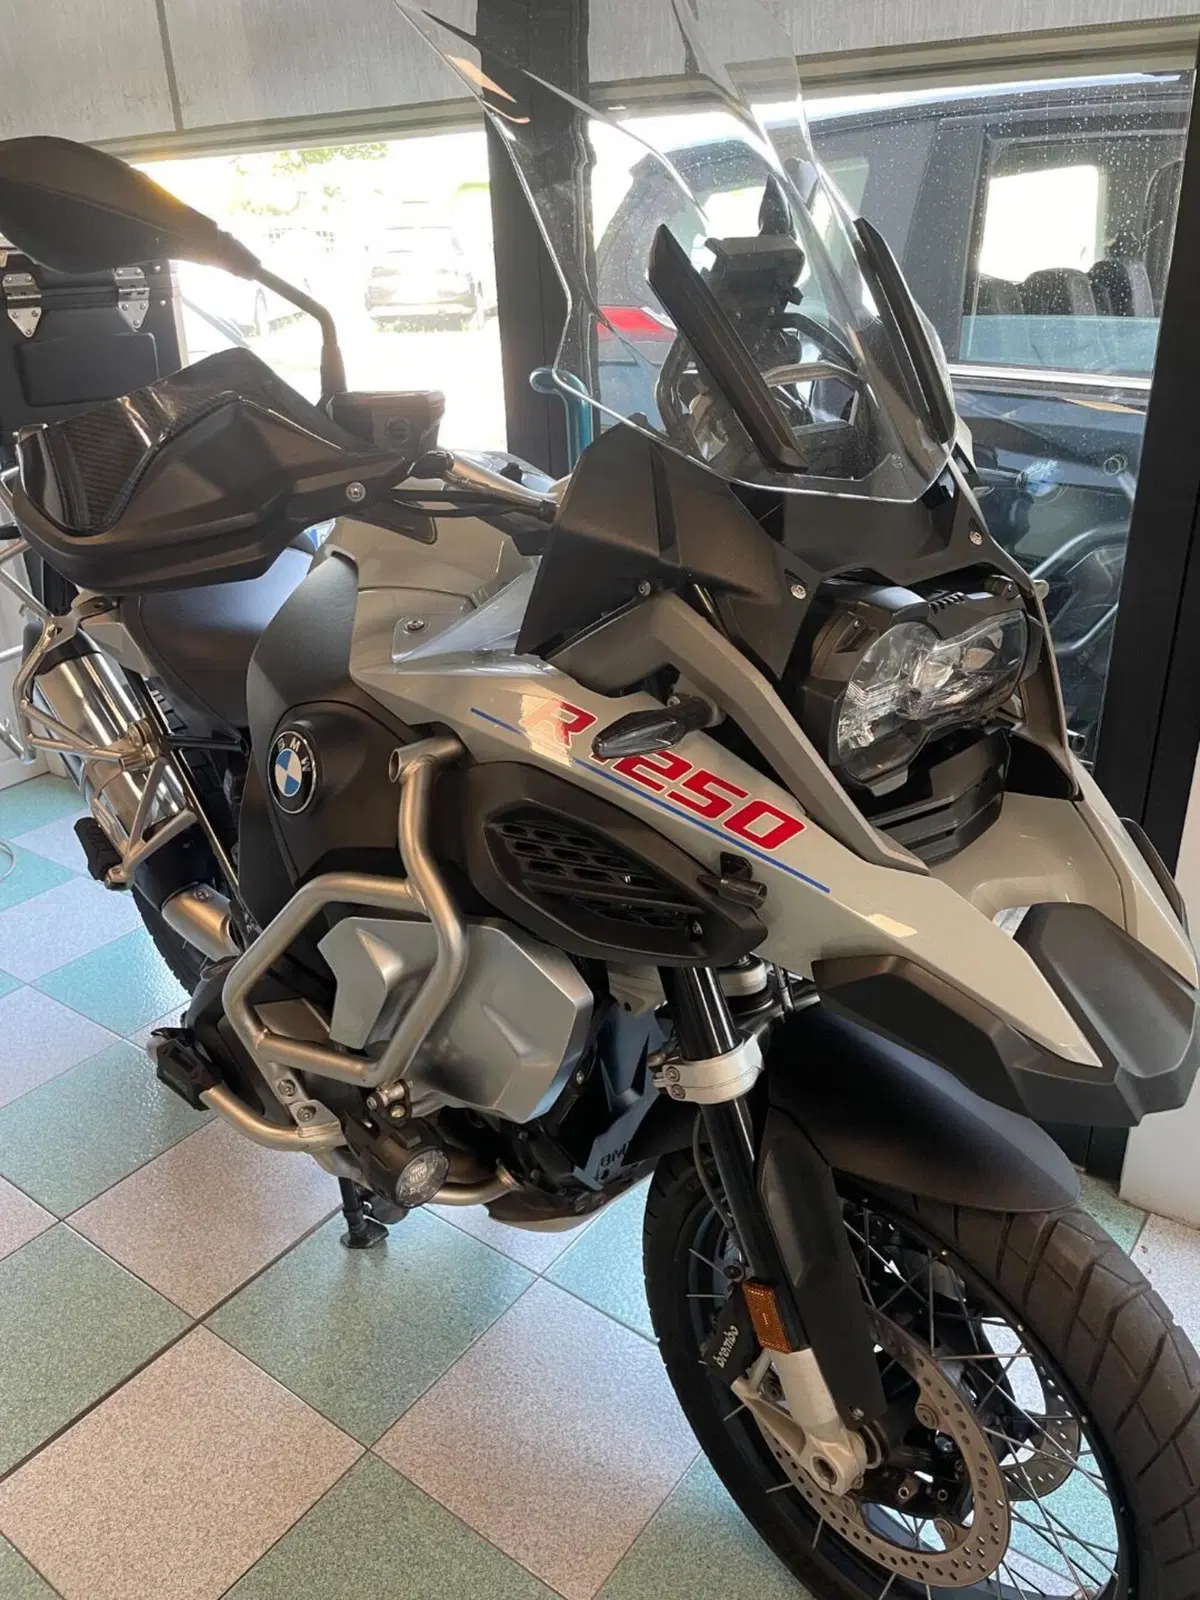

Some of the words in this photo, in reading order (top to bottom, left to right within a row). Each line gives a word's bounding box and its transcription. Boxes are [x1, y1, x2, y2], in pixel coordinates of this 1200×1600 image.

[277, 737, 311, 772] BMW
[519, 696, 598, 748] R
[589, 750, 806, 850] 250
[600, 1142, 627, 1168] BM
[713, 1325, 739, 1369] brembo
